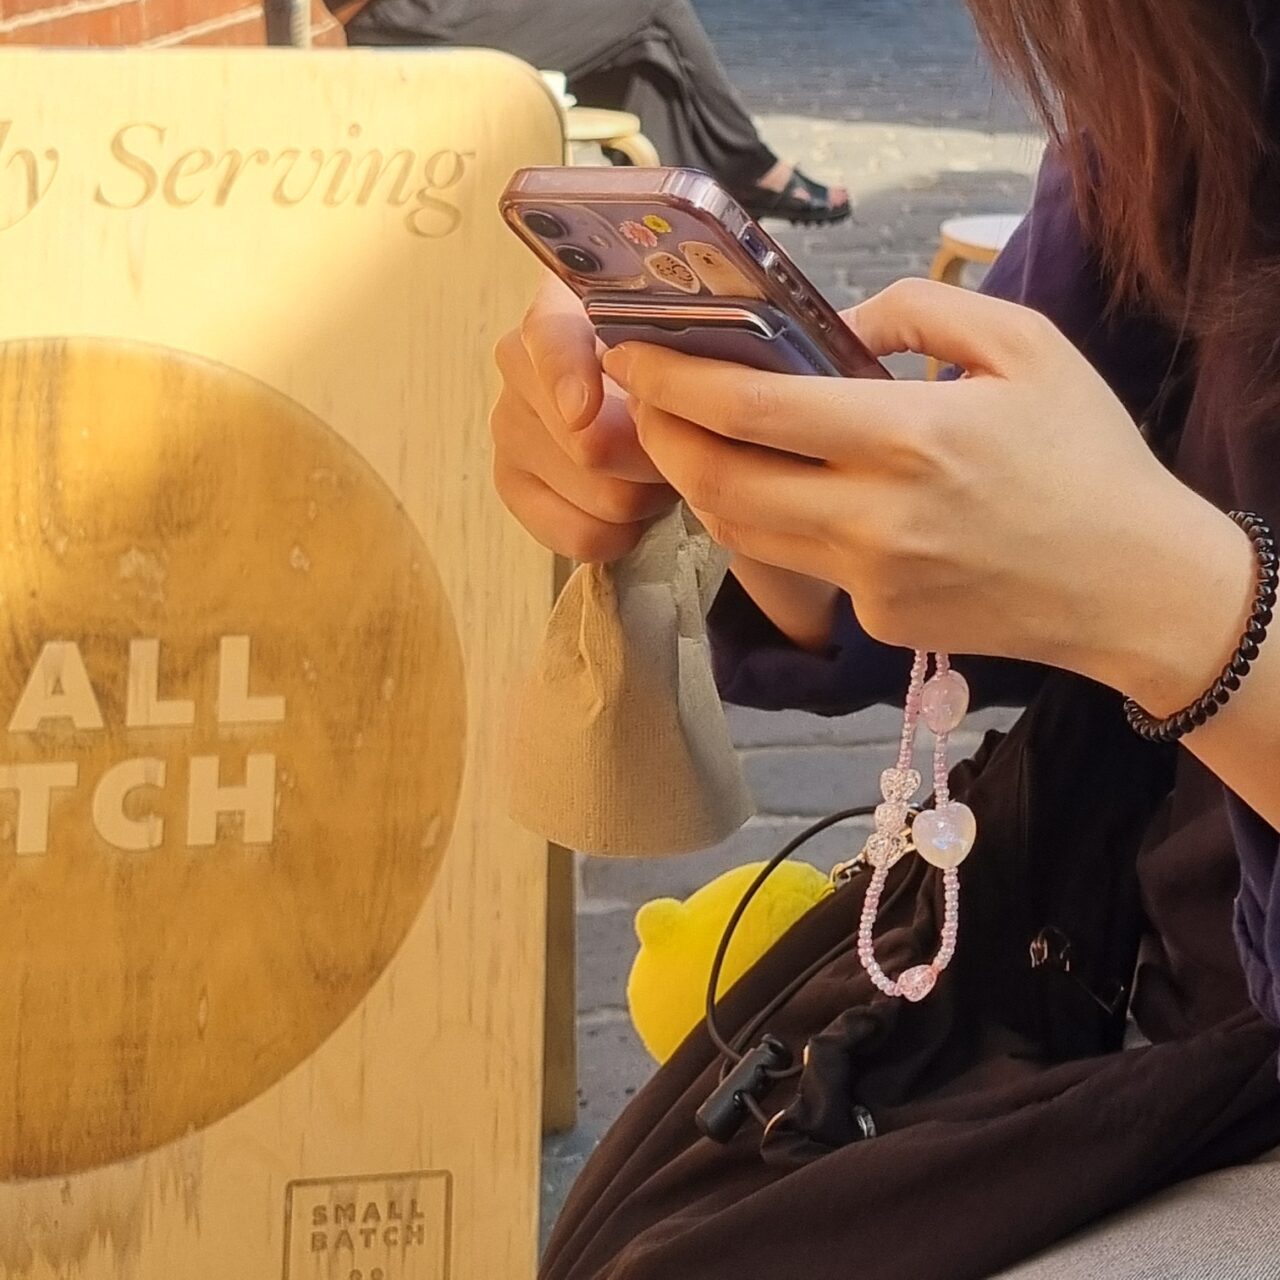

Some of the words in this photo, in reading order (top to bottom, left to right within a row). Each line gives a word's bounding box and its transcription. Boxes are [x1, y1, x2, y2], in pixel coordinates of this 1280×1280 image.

[94, 123, 477, 238] Serving
[8, 635, 286, 732] ALL
[0, 754, 276, 854] TCH
[311, 1223, 425, 1252] BATCH
[312, 1198, 425, 1226] SMALL
